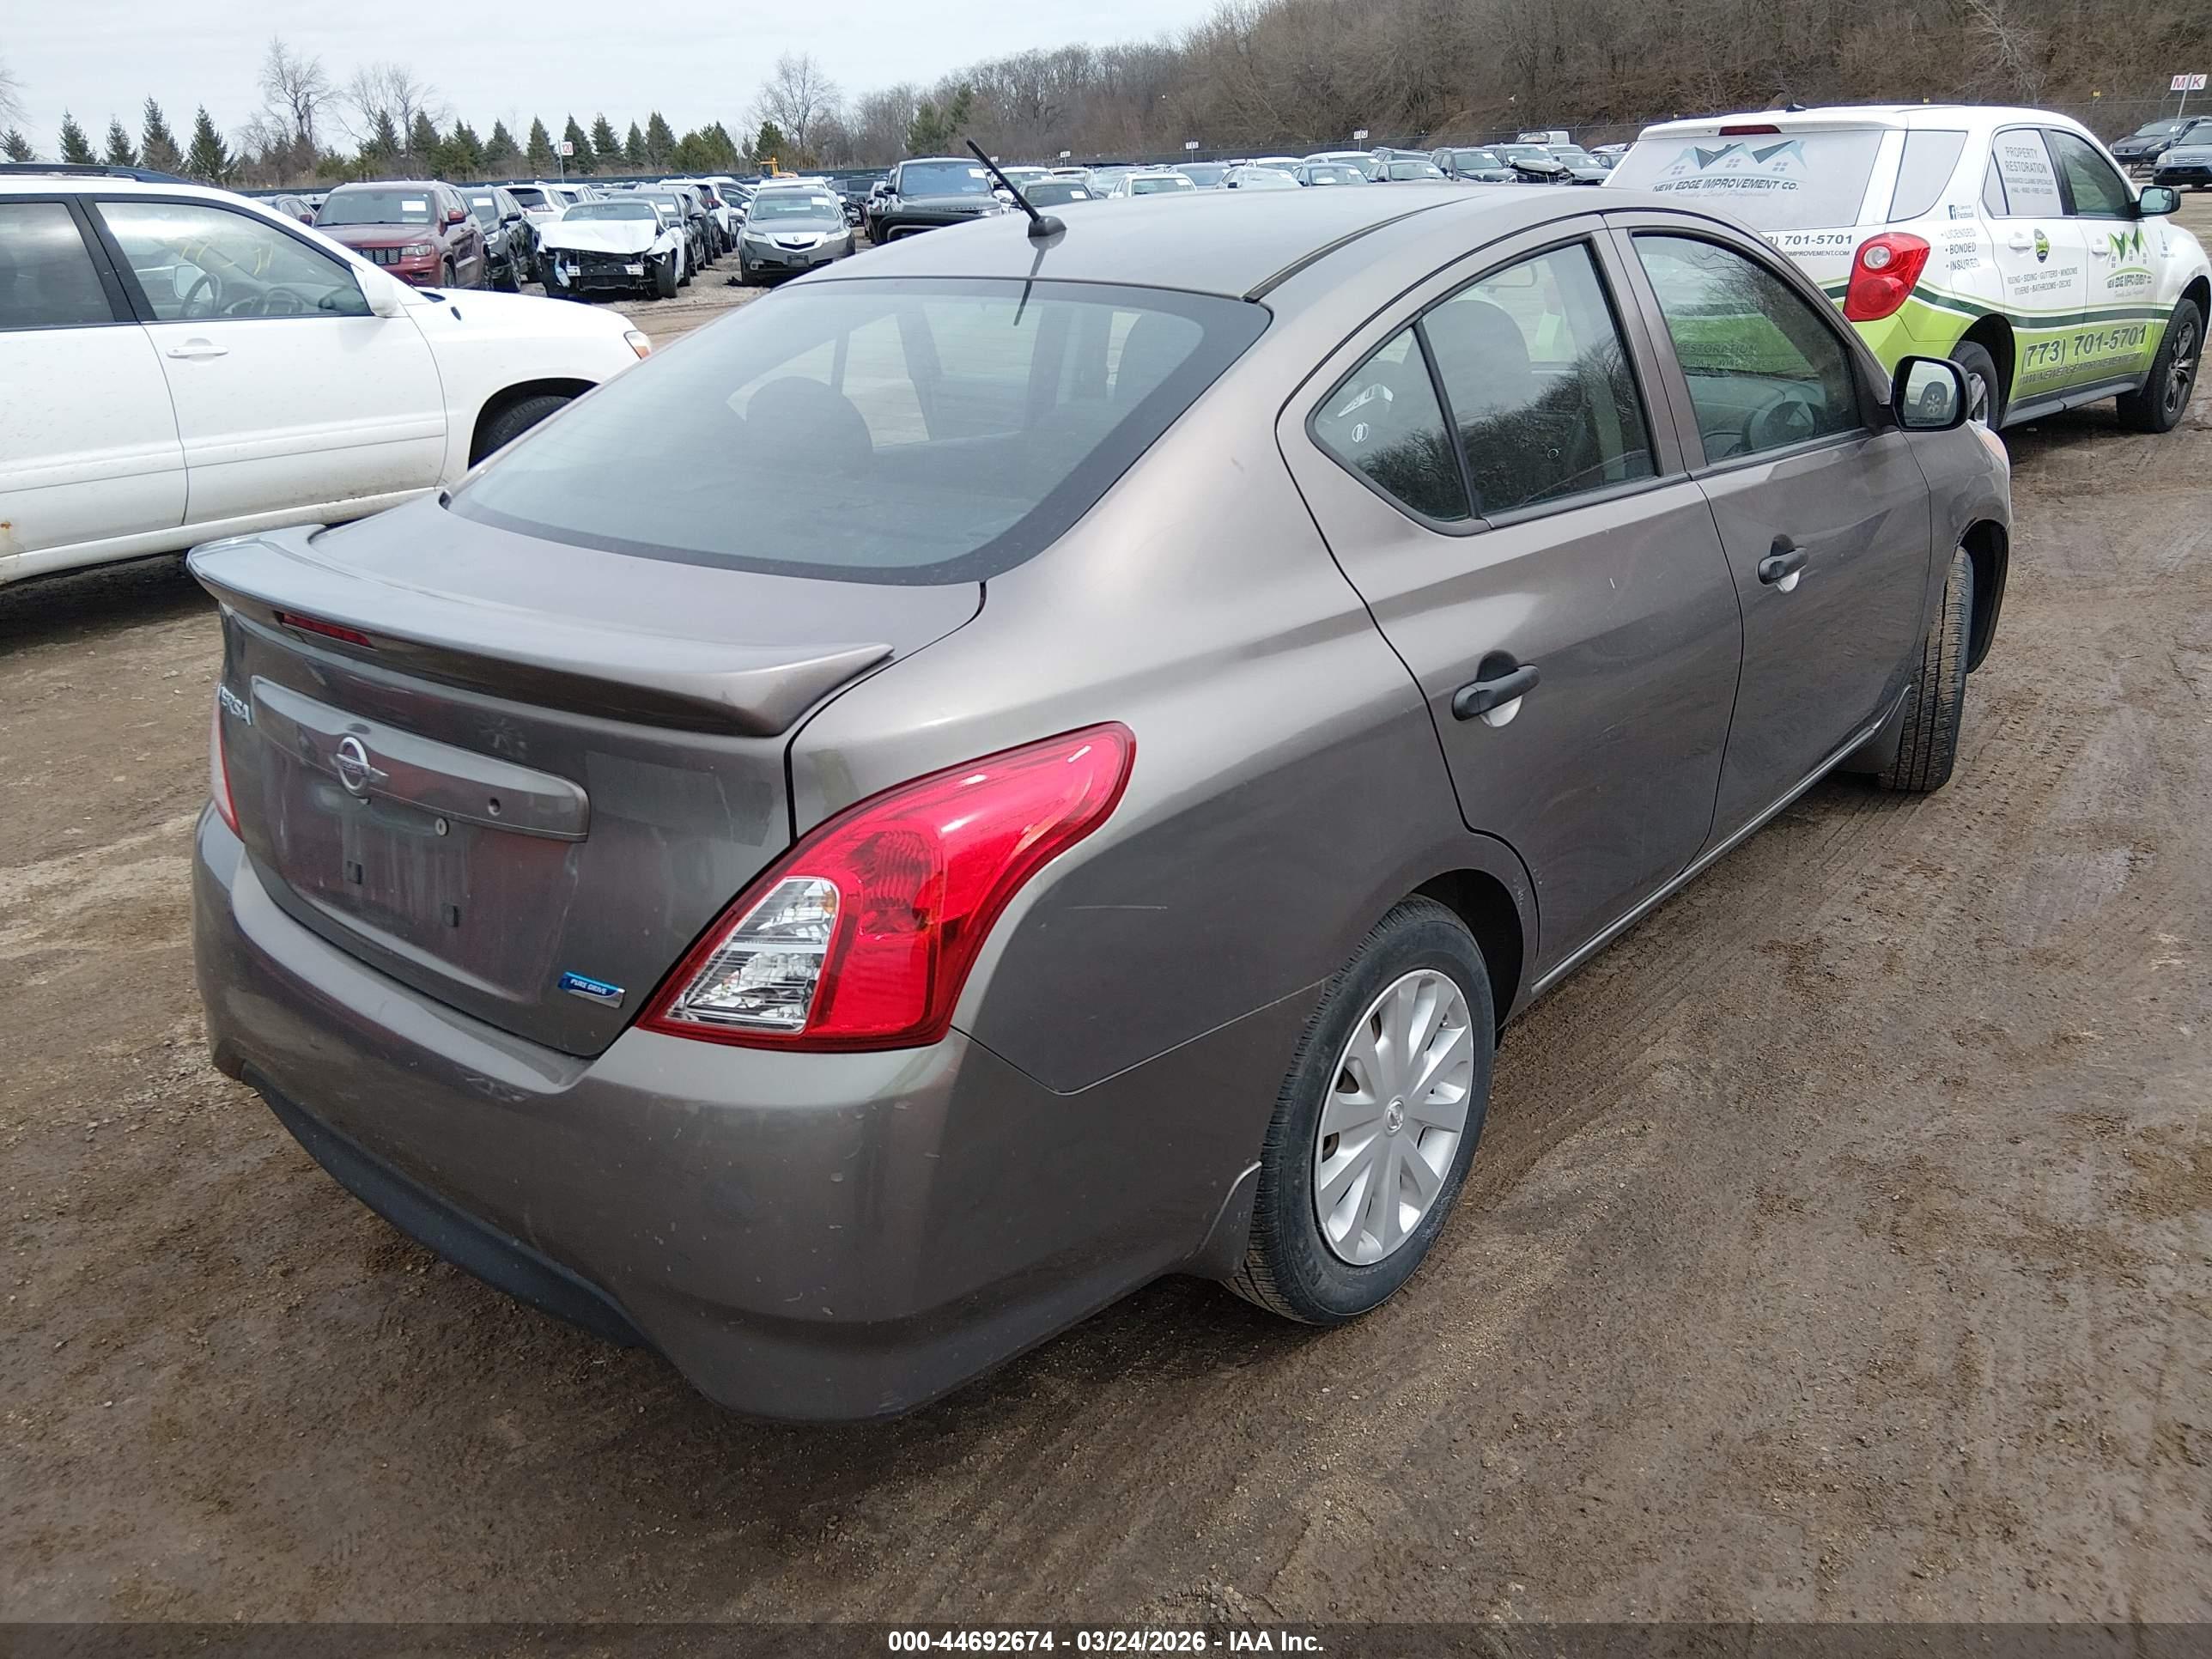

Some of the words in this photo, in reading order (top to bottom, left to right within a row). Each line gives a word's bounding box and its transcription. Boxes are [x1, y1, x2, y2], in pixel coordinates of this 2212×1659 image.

[2172, 77, 2186, 88] M
[2191, 76, 2203, 88] K
[2005, 147, 2039, 158] PROPERTY
[2005, 161, 2048, 174] RESTORATION
[1652, 184, 1674, 192] NEW
[1675, 179, 1702, 190] EDGE
[1702, 178, 1780, 190] IMPROVEMENT
[1782, 182, 1800, 191] CO.
[1785, 234, 1853, 245] 701-5701
[1949, 242, 1977, 254] BONDED
[1950, 258, 1980, 270] INSURED
[2021, 338, 2067, 374] (773)
[2074, 325, 2147, 356] 701-5701
[570, 978, 587, 988] PURE
[587, 984, 607, 995] DRIVE
